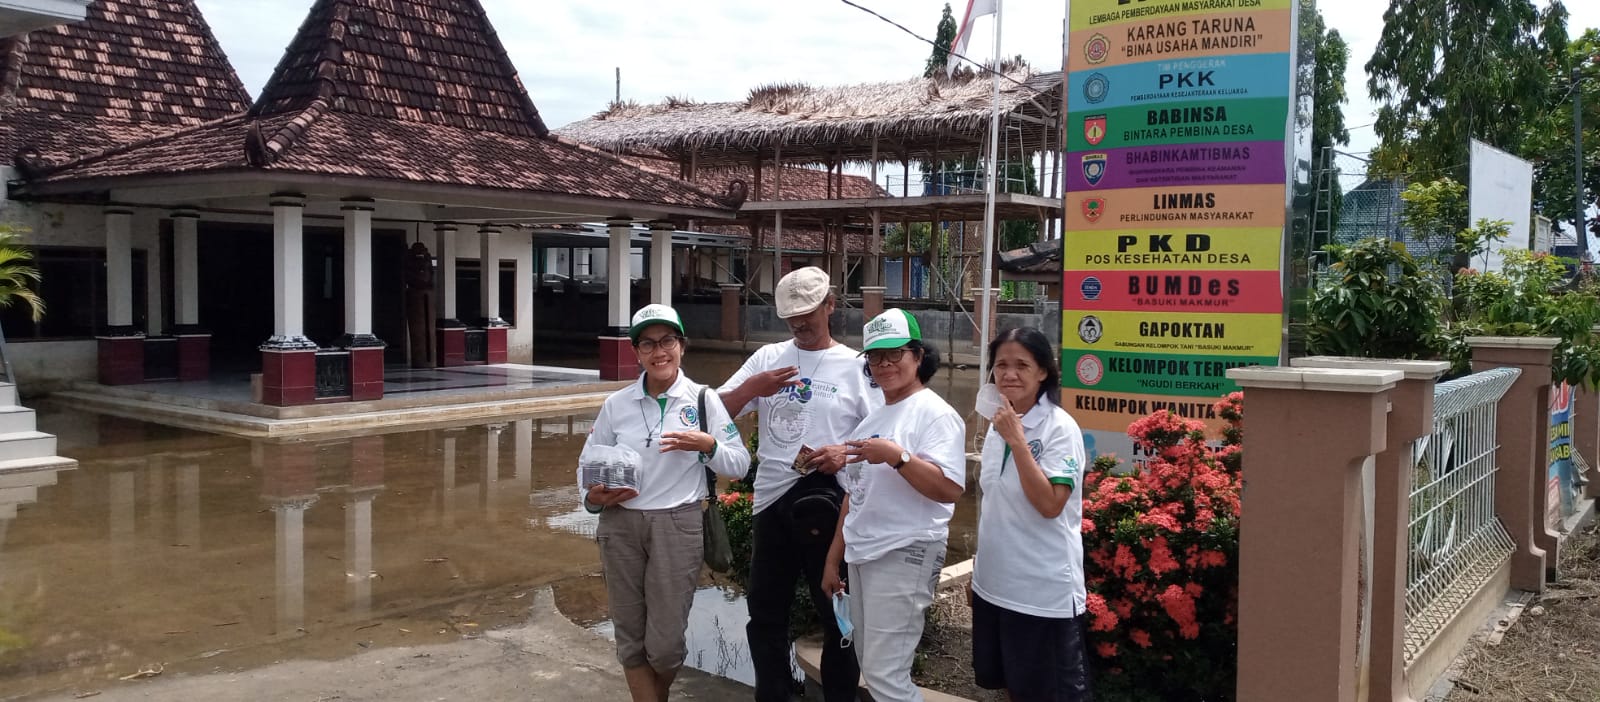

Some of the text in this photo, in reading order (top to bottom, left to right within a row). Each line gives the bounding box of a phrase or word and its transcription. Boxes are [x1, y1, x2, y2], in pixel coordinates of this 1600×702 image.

[1089, 12, 1120, 25] LEMBAGA
[1121, 5, 1180, 22] PEMBERDAYAAN
[1182, 0, 1236, 12] MASYARAKAT
[1127, 16, 1255, 42] KARANG TARUNA
[1156, 37, 1198, 53] USAHA
[1159, 70, 1216, 90] PKK
[1131, 92, 1170, 101] PEMBERDAYAAN
[1218, 88, 1248, 96] KELUARGA
[1147, 106, 1227, 125] BABINSA
[1123, 124, 1254, 141] BINTARA PEMBINA DESA
[1126, 147, 1250, 165] BHABINKAMTIBMAS
[1153, 192, 1216, 210] LINMAS
[1120, 211, 1254, 222] PERLINDUNGAN MASYARAKAT
[1117, 234, 1211, 253] PKD
[1085, 253, 1251, 265] POS KESEHATAN DESA
[1128, 275, 1240, 296] BUMDes
[1139, 321, 1225, 339] GAPOKTAN
[1108, 357, 1190, 376] KELOMPOK
[1075, 395, 1147, 415] KELOMPOK
